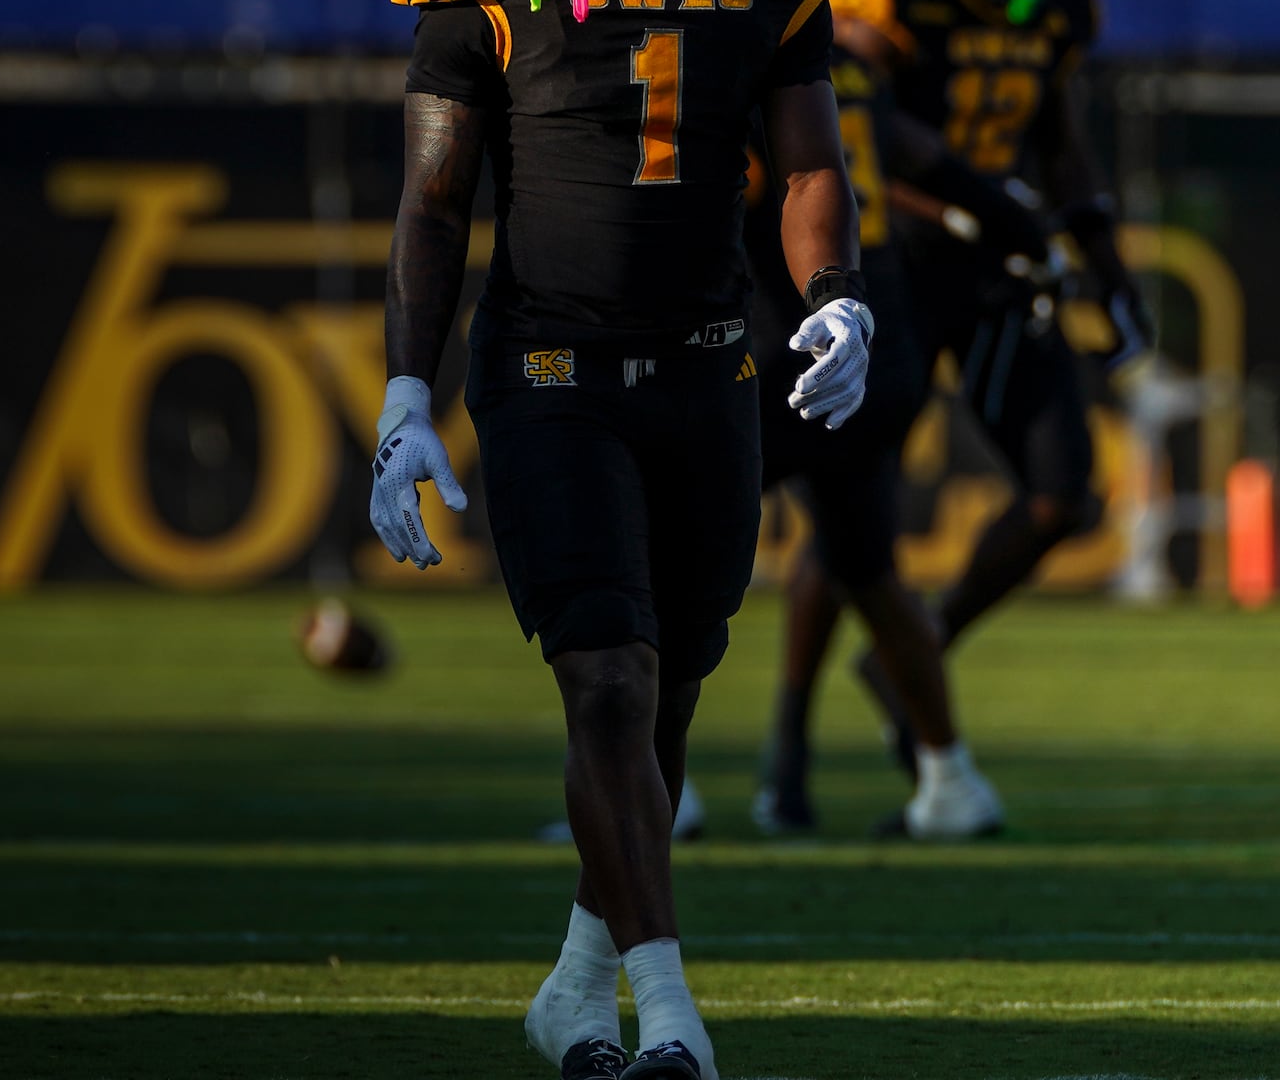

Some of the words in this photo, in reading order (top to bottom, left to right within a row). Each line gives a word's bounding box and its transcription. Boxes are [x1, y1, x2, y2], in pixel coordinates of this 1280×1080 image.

[630, 28, 685, 185] 1
[944, 67, 1041, 174] 12
[813, 355, 840, 382] ADIZERO
[402, 509, 421, 543] ADIZERO
